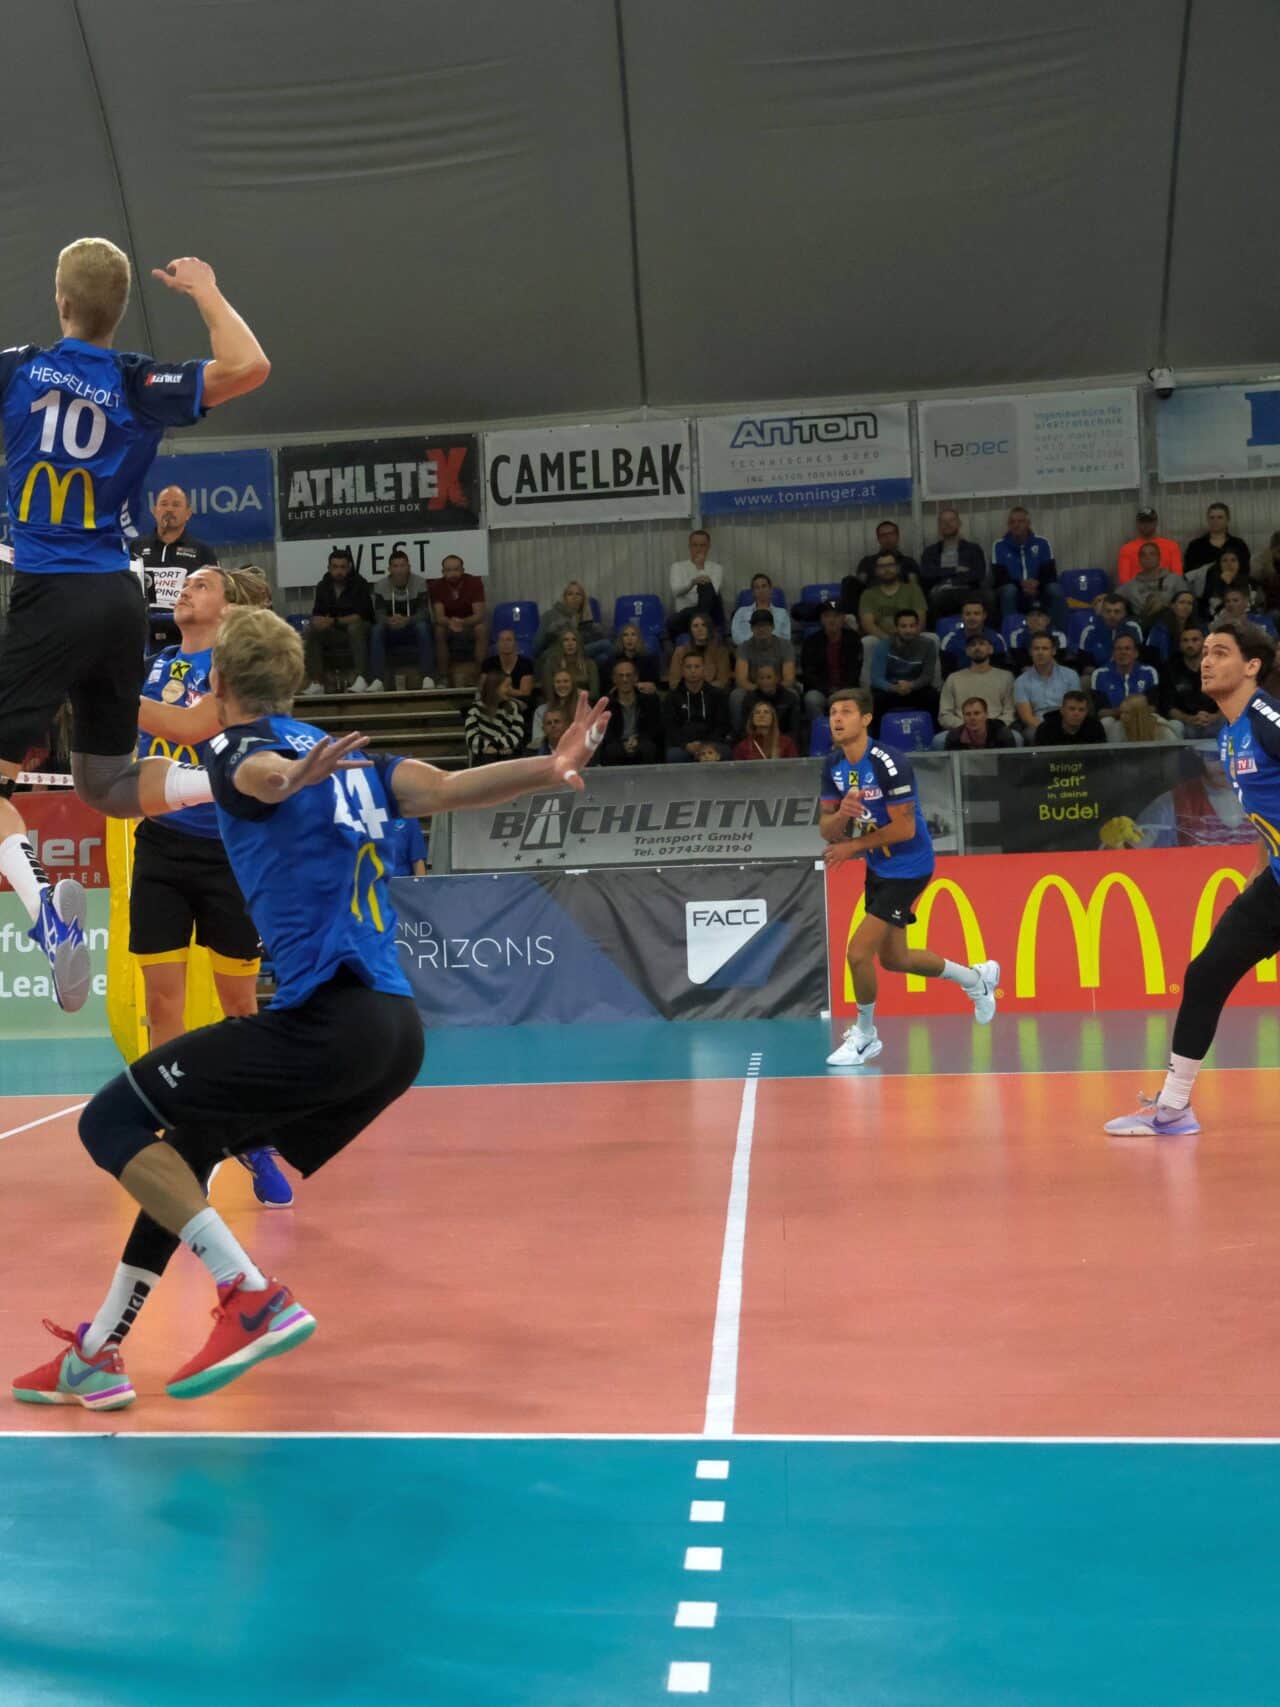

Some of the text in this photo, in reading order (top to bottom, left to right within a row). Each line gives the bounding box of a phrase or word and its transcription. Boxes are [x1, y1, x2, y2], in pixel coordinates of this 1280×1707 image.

[29, 365, 120, 408] HESSELHOLT
[30, 389, 107, 460] 10
[729, 411, 879, 449] ANTON
[489, 443, 686, 507] CAMELBAK
[148, 484, 263, 514] IQA
[733, 484, 877, 507] www.tonninger.at
[287, 502, 421, 520] ELITE PERFORMANCE BOX
[153, 571, 182, 579] PORT
[154, 580, 177, 588] HNE
[1039, 802, 1099, 821] Bude!
[633, 831, 754, 846] Transport GmbH
[632, 843, 752, 857] Tel. 07743/8219-0
[692, 908, 760, 927] FACC
[394, 935, 555, 969] RIZONS
